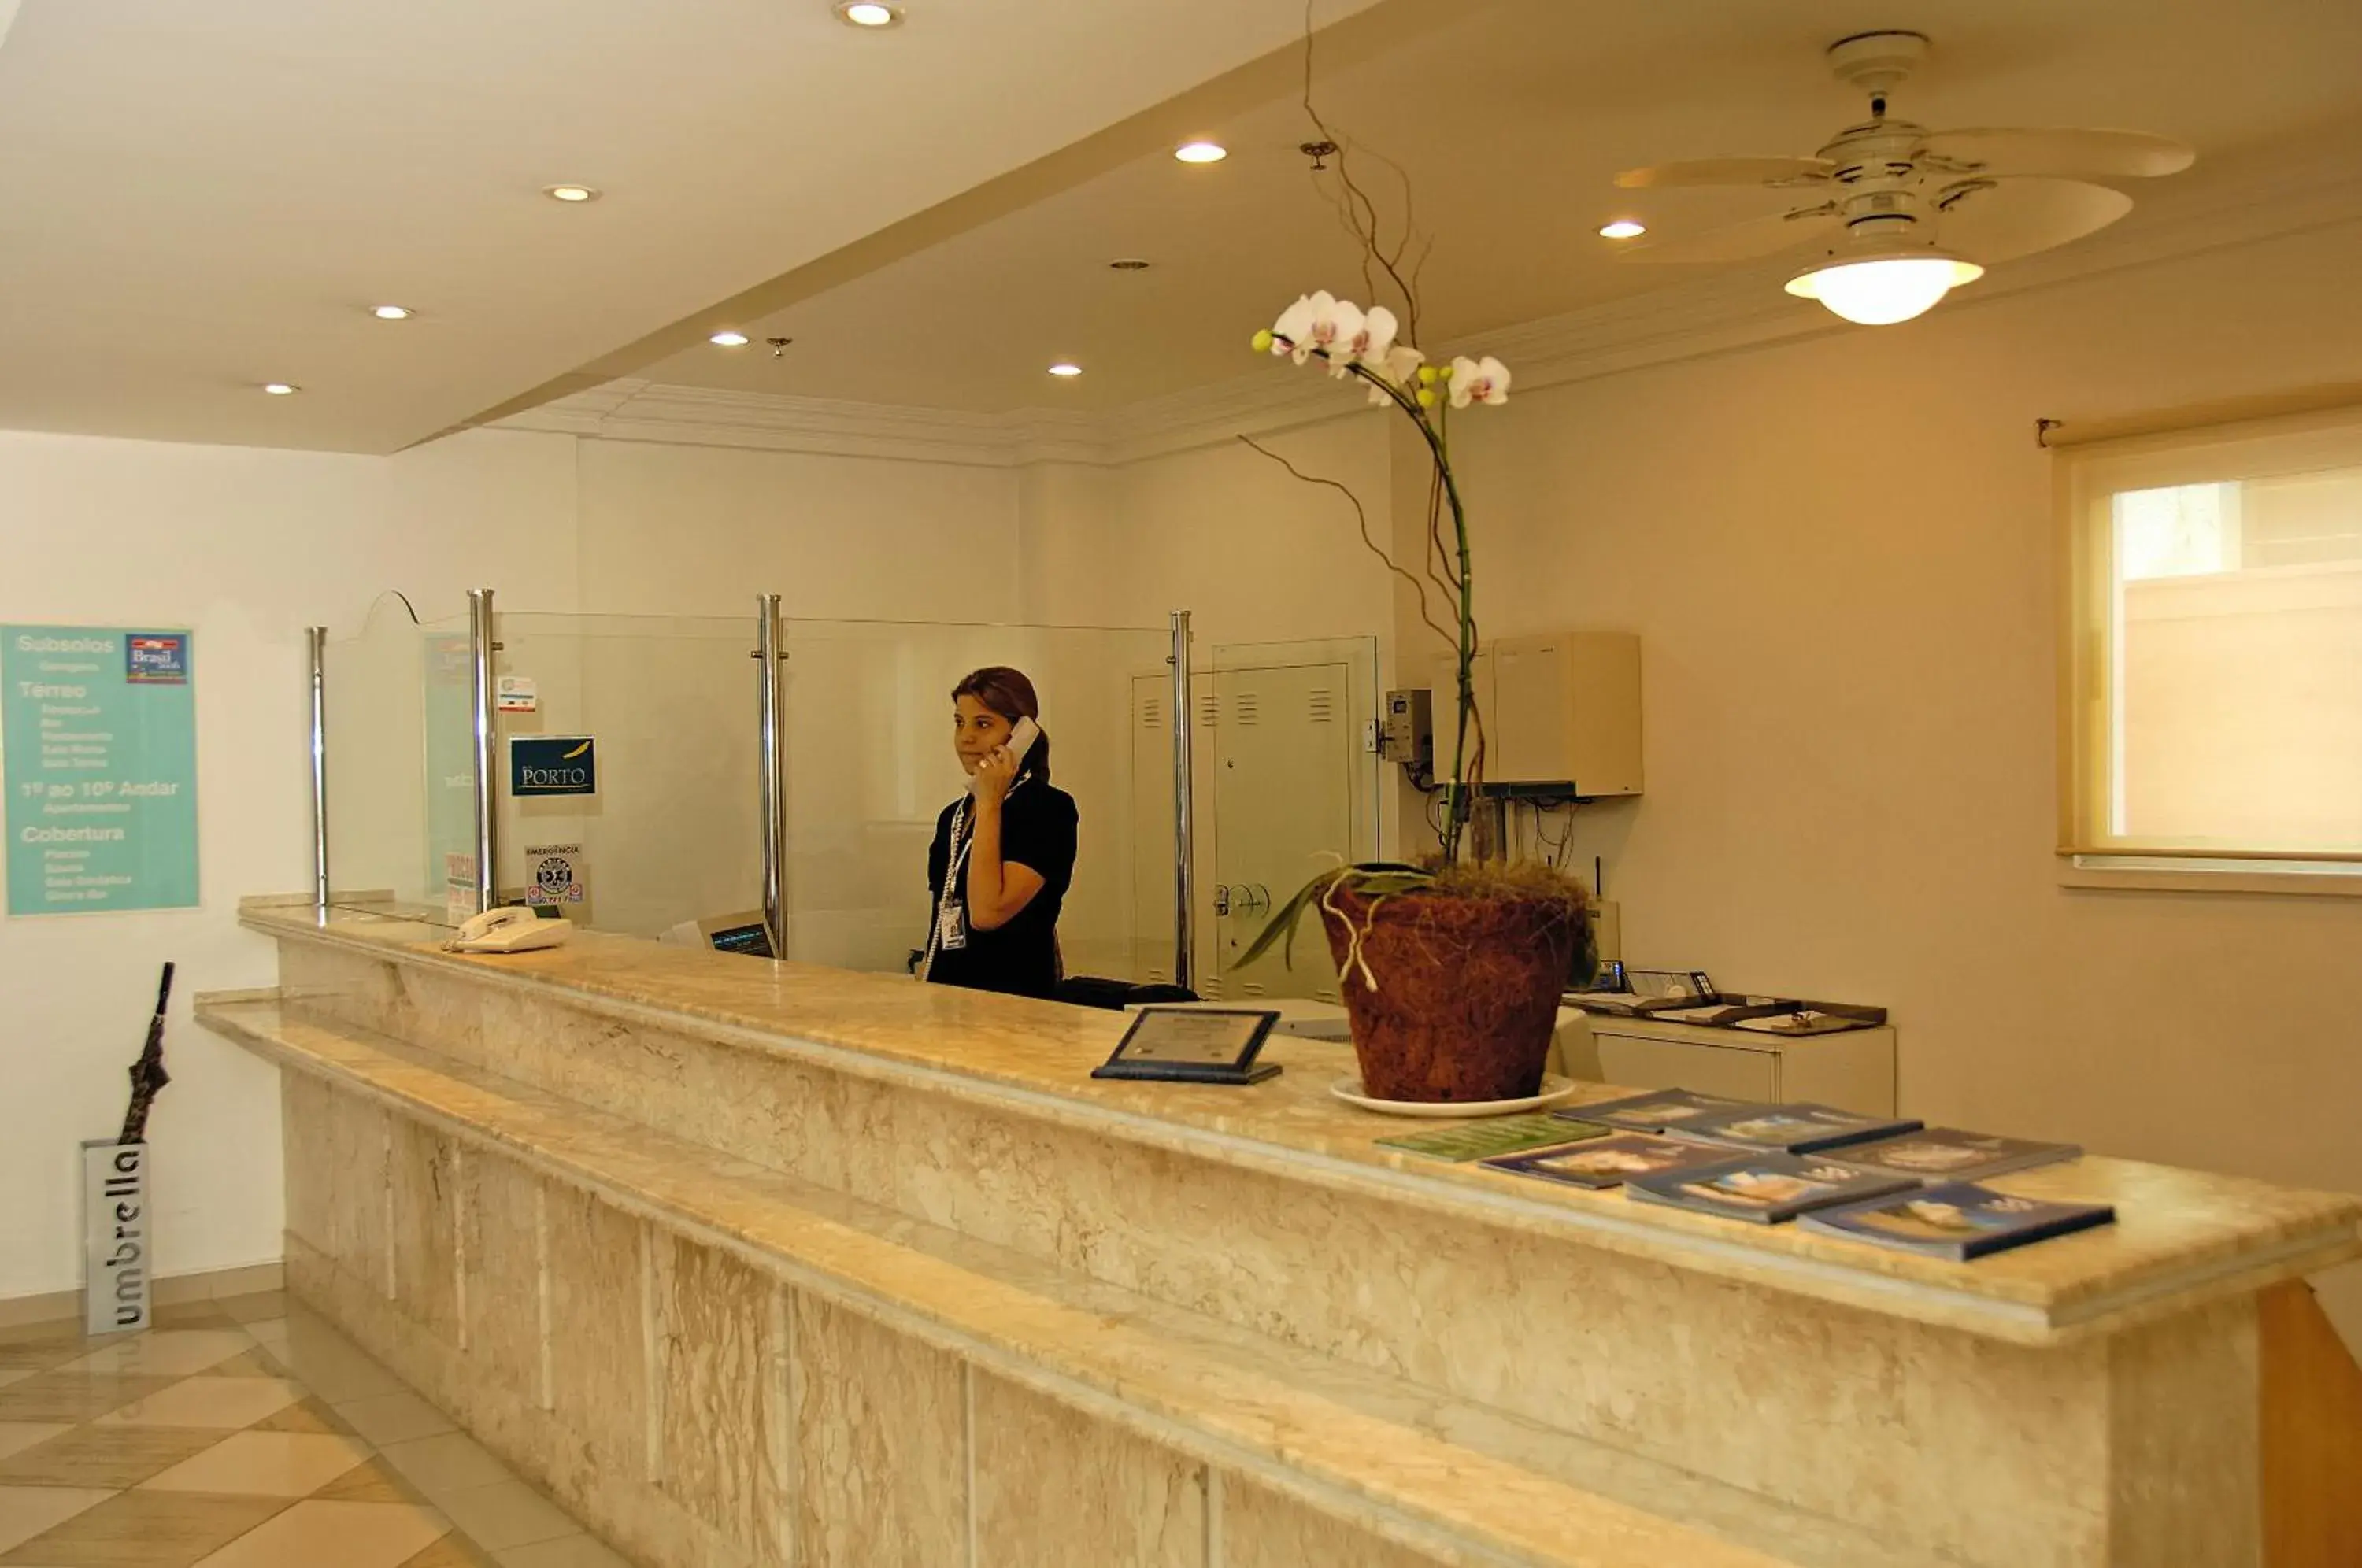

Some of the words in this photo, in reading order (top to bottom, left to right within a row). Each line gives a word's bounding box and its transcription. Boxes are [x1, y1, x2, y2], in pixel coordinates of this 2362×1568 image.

[17, 634, 115, 653] Subsolos
[523, 767, 585, 785] PORTO
[119, 780, 180, 797] Andar
[20, 825, 125, 844] Cobertura
[105, 1150, 143, 1326] umbrella
